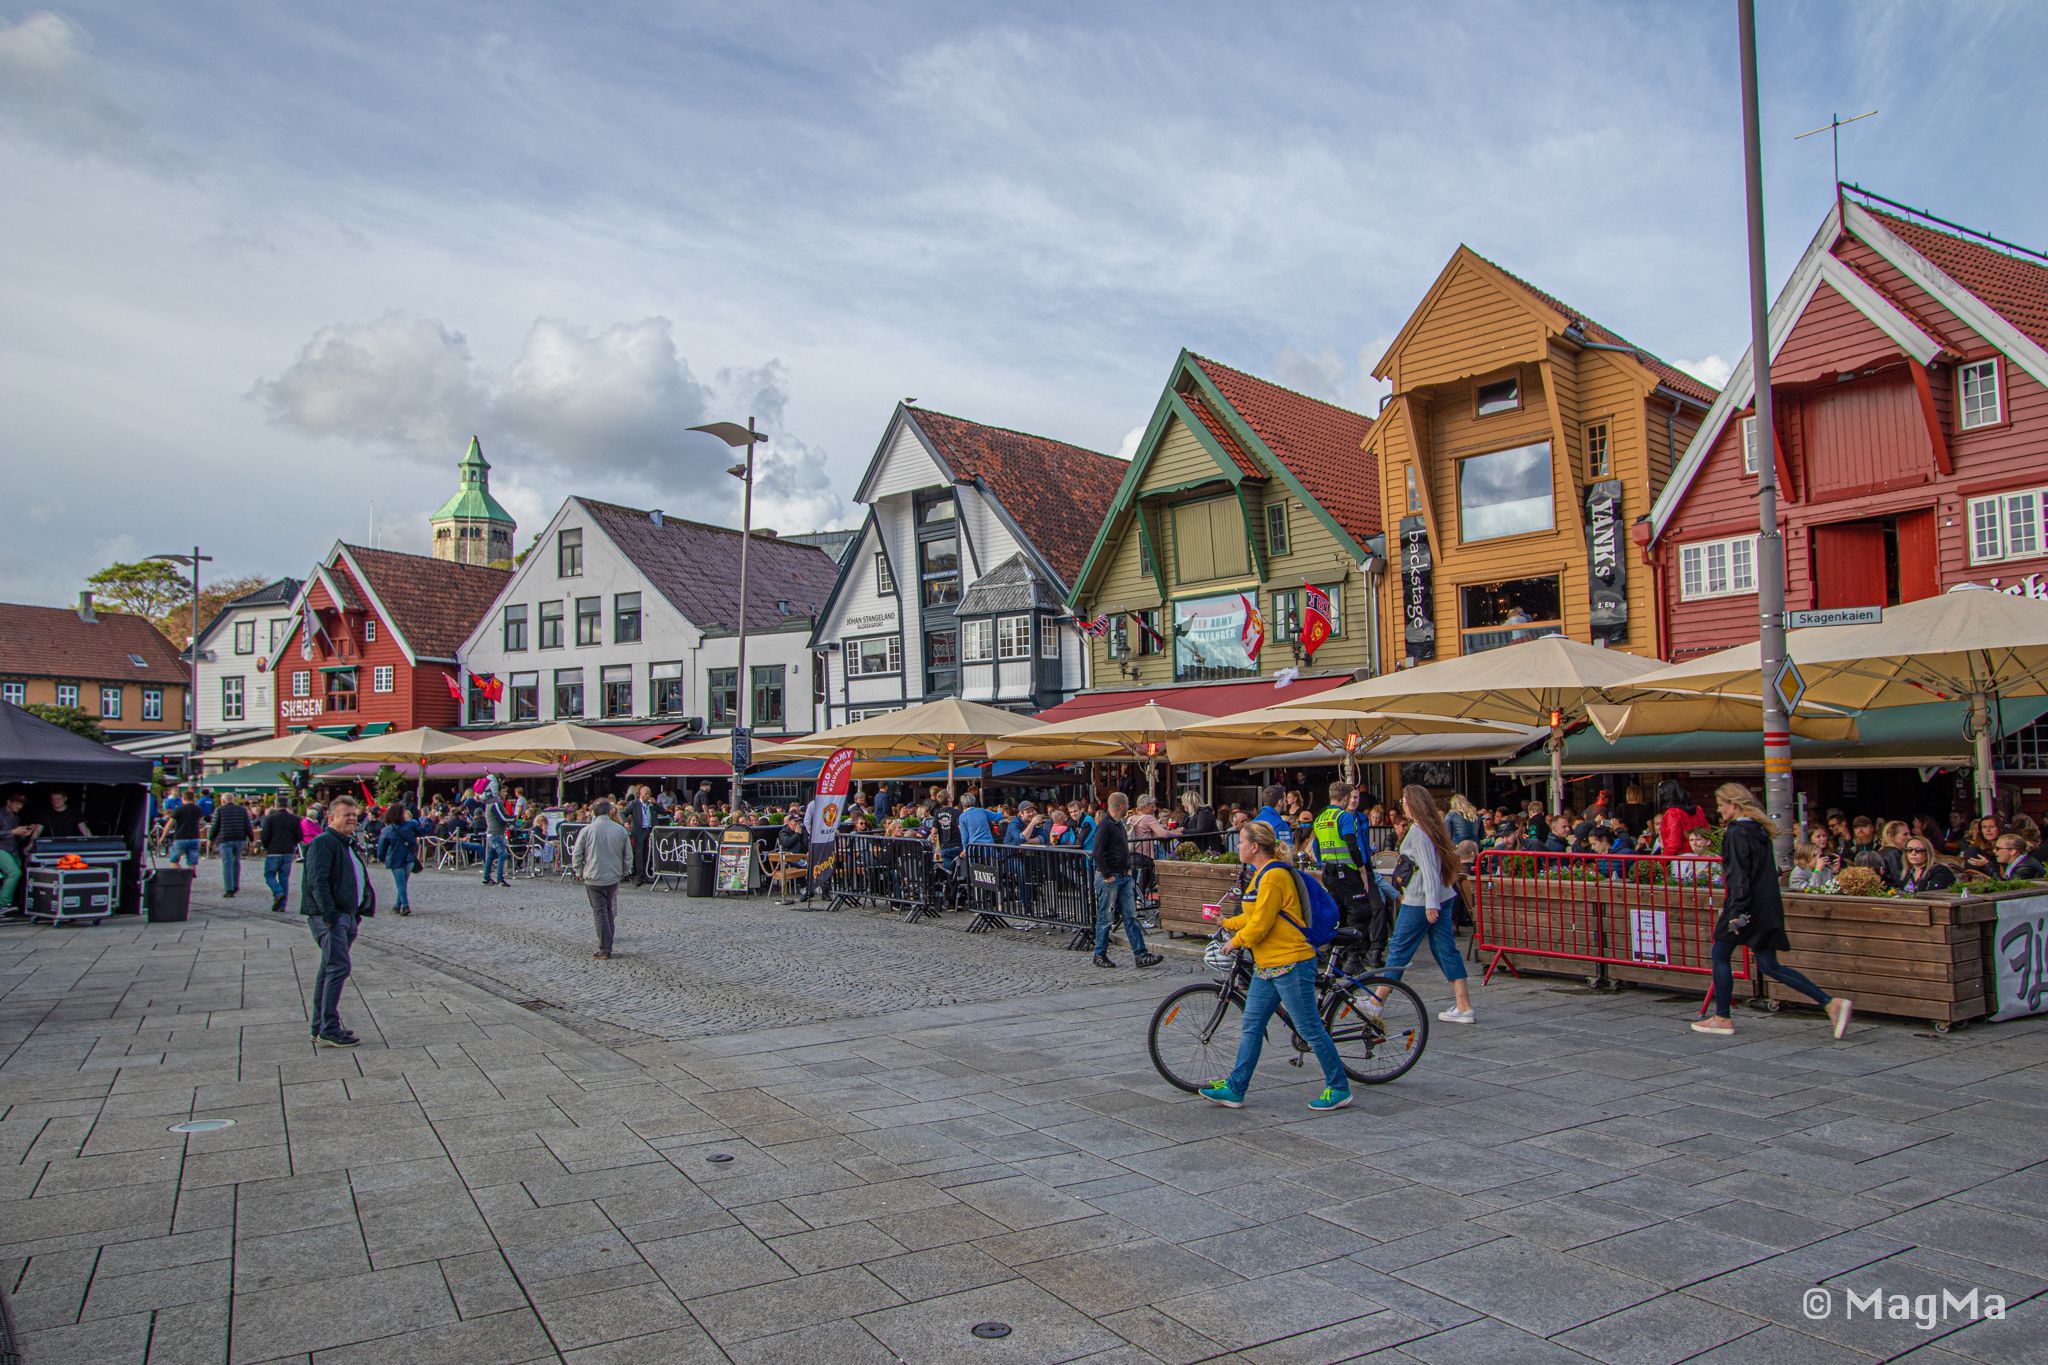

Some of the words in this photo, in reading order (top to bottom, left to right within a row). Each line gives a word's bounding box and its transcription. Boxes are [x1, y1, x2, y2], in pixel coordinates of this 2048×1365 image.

[1591, 498, 1617, 577] YANK's
[1407, 529, 1428, 628] backstage
[1604, 601, 1616, 609] Etg
[846, 616, 863, 626] JOHAN
[863, 612, 896, 623] STANGELAND
[1193, 618, 1208, 629] RED
[1210, 615, 1233, 629] ARMY
[1799, 610, 1874, 624] Skagenkaien
[821, 772, 831, 794] RED
[828, 750, 853, 771] ARMY
